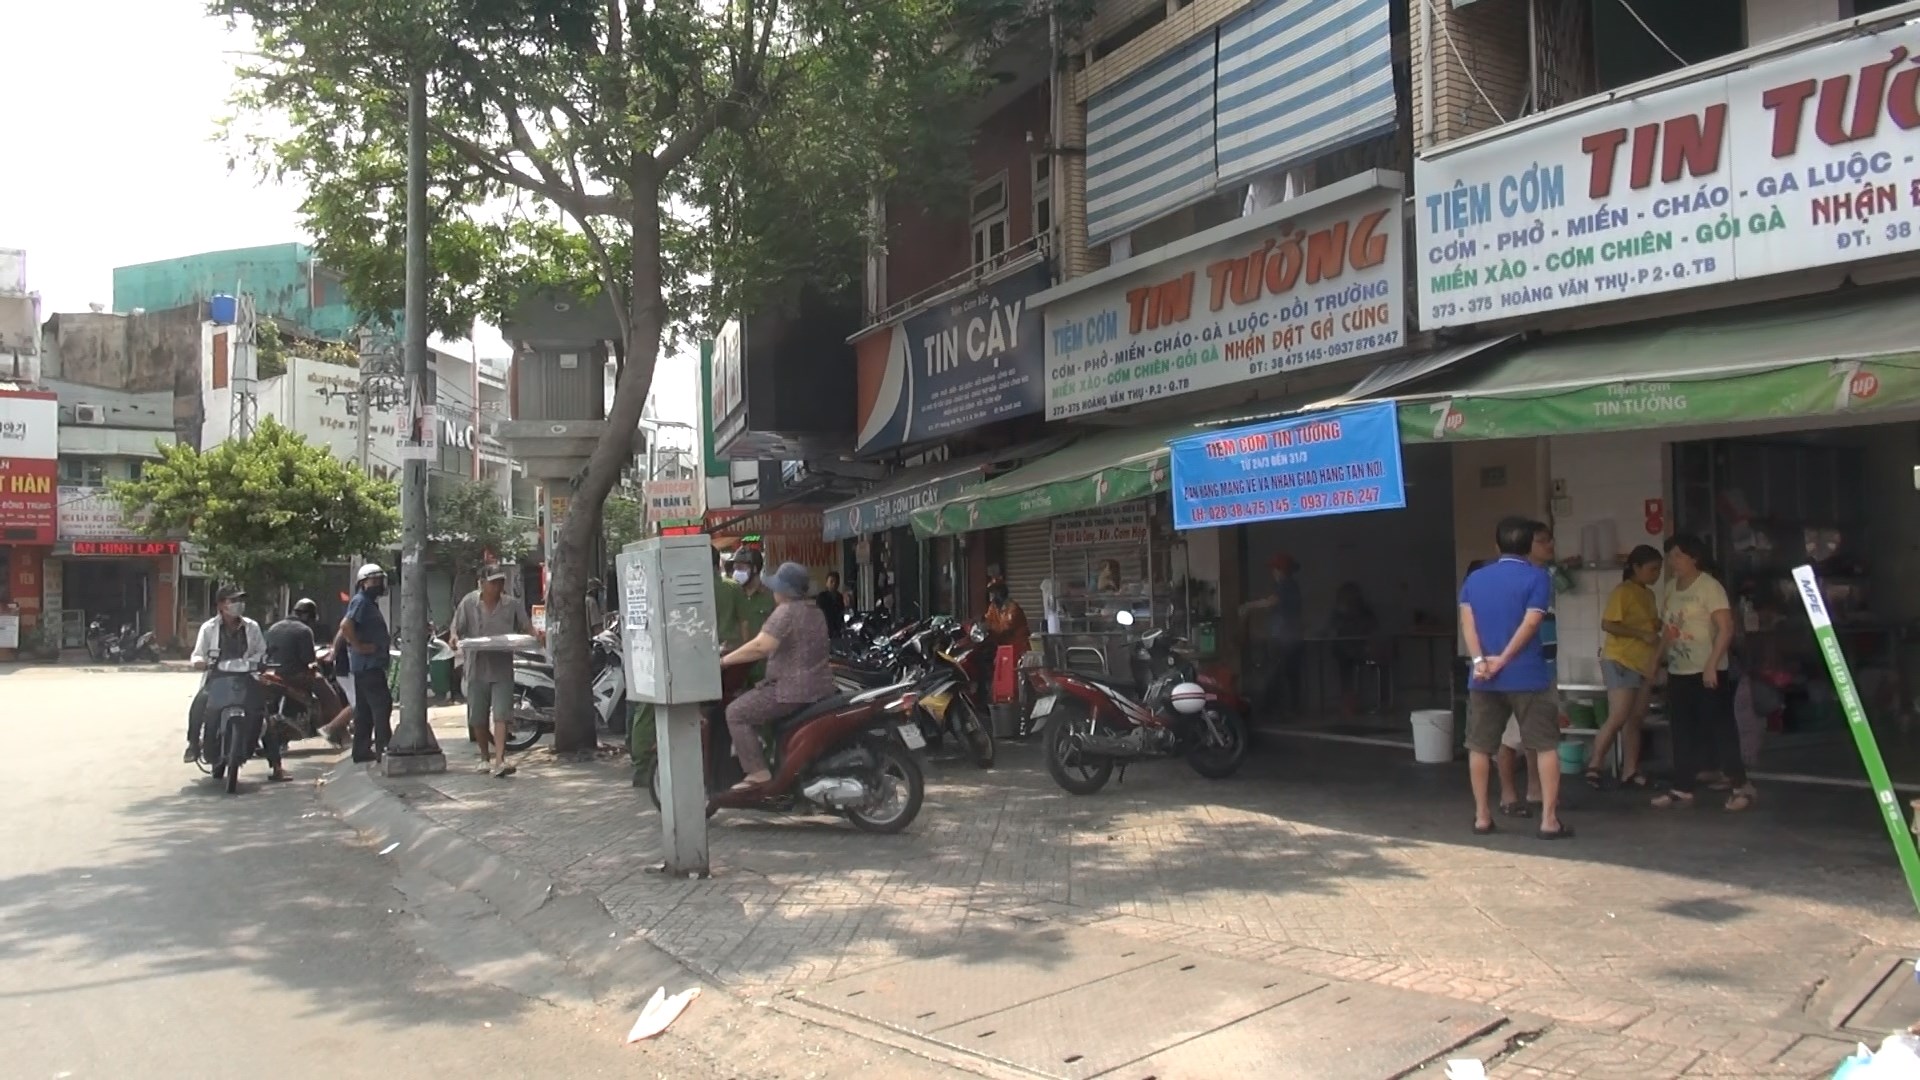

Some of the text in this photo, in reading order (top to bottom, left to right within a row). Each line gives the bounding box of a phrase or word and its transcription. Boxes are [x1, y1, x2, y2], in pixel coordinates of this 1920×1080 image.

[1581, 103, 1727, 198] TIN
[1426, 161, 1565, 237] TIỆM CƠM
[1429, 239, 1476, 264] CƠM
[1497, 219, 1545, 251] PHỞ
[1567, 203, 1628, 238] MIẾN
[1653, 183, 1729, 218] CHÁO
[1808, 151, 1892, 188] LUỘC
[1811, 181, 1898, 226] NHẬN
[1431, 263, 1478, 294] MIẾN
[1484, 256, 1527, 285] XÀO
[1545, 246, 1594, 273] CƠM
[1601, 231, 1672, 262] CHIÊN
[1749, 204, 1786, 234] GÀ
[1885, 221, 1912, 242] 38
[1126, 208, 1391, 335] TIN TƯỞNG
[1432, 302, 1456, 319] 373
[1468, 296, 1493, 313] 375
[1501, 285, 1553, 308] HOÀNG
[1595, 272, 1628, 294] THỤ
[924, 296, 1021, 377] TIN CẬY
[1052, 364, 1075, 380] CƠM
[1115, 341, 1145, 364] MIẾN
[1154, 331, 1192, 354] CHÁO
[1228, 312, 1269, 336] LUỘC
[1315, 279, 1389, 313] TRƯỜNG
[1052, 309, 1118, 360] TIỆM CƠM
[1107, 368, 1130, 385] CƠM
[1134, 359, 1170, 379] CHIÊN
[11, 473, 51, 493] HÀN
[1801, 579, 1822, 614] MPE
